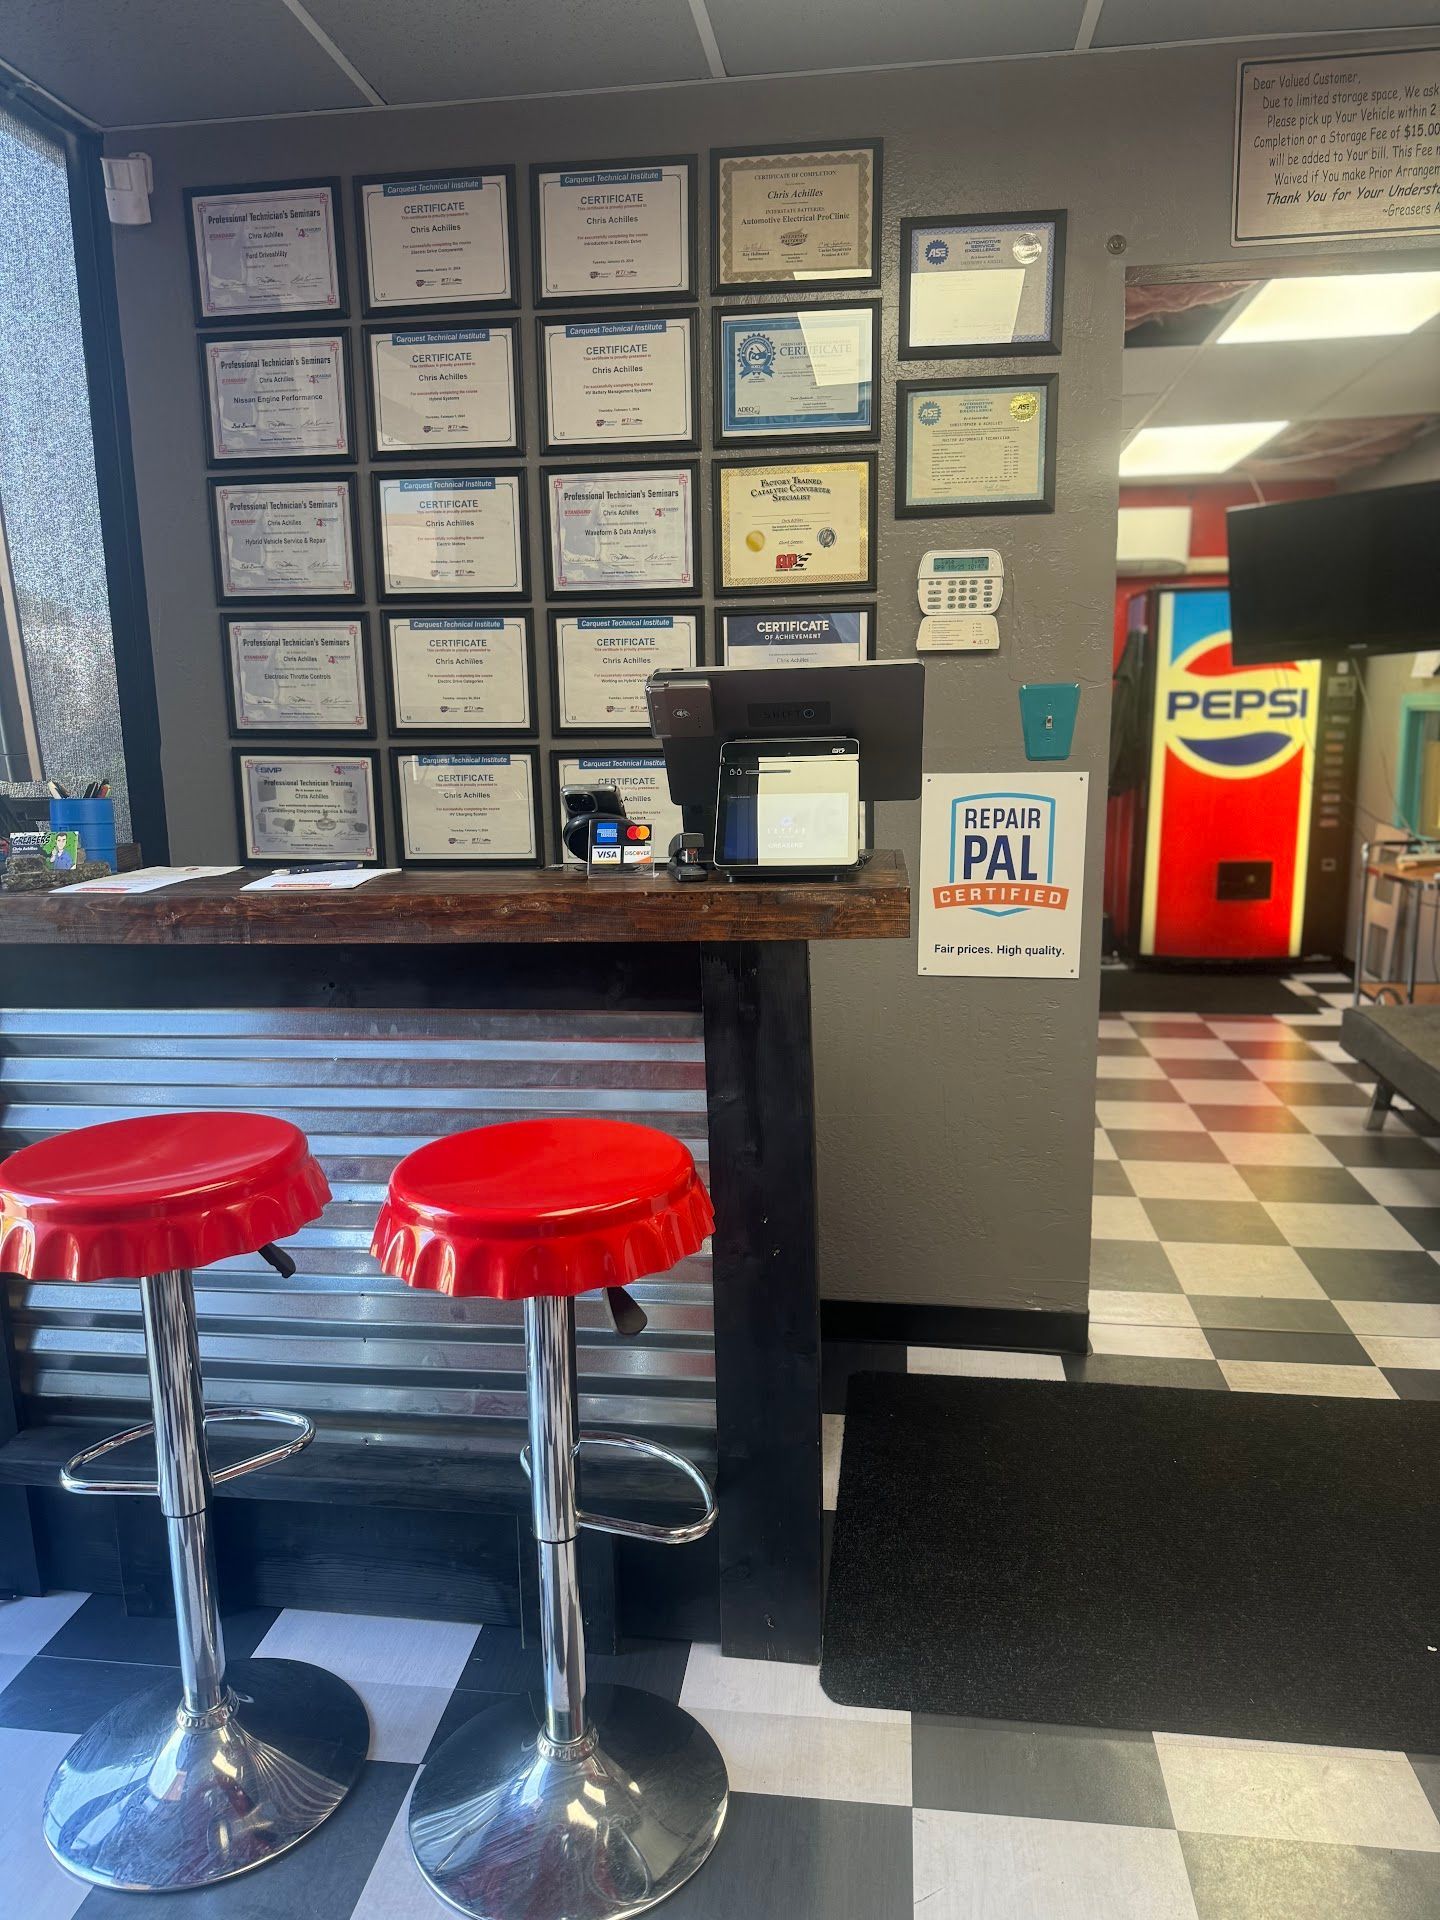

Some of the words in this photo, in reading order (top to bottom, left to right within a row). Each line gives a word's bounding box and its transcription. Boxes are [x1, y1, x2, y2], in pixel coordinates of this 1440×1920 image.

[1253, 78, 1275, 90] Dear
[1280, 74, 1310, 87] Valued
[1313, 73, 1361, 85] Customer,
[1263, 97, 1280, 109] Due
[1284, 97, 1293, 107] to
[1297, 94, 1329, 106] limited
[1332, 91, 1368, 107] storage
[1371, 89, 1401, 104] space,
[1404, 86, 1420, 97] We
[1423, 84, 1439, 97] ask
[1268, 115, 1297, 128] Please
[1300, 114, 1319, 130] pick
[1322, 115, 1332, 127] up
[1335, 111, 1358, 124] Your
[1361, 107, 1395, 121] Vehicle
[1398, 104, 1428, 118] within
[1430, 104, 1436, 115] 2
[1254, 134, 1305, 150] Completion
[1307, 134, 1317, 144] or
[1321, 134, 1326, 143] a
[1329, 131, 1367, 145] Storage
[1370, 127, 1387, 140] Fee
[1390, 126, 1400, 138] of
[1404, 123, 1440, 138] $15.00
[1269, 153, 1284, 167] will
[1288, 154, 1299, 165] be
[1302, 150, 1330, 164] added
[1334, 152, 1343, 162] to
[1346, 149, 1369, 162] Your
[1371, 145, 1389, 159] bill.
[1392, 145, 1413, 158] This
[1416, 143, 1433, 156] Fee
[564, 176, 595, 184] Carquest
[630, 172, 658, 180] Institute
[1275, 171, 1308, 186] Waived
[1312, 171, 1319, 183] if
[1322, 170, 1339, 182] You
[1342, 168, 1366, 181] make
[1369, 166, 1392, 179] Prior
[388, 185, 417, 194] Carquest
[419, 183, 450, 191] Technical
[452, 180, 479, 188] Institute
[580, 193, 644, 205] CERTIFICATE
[768, 190, 789, 200] Chris
[791, 189, 823, 198] Achilles
[1266, 192, 1301, 205] Thank
[1306, 190, 1326, 202] You
[1332, 188, 1351, 202] for
[1357, 187, 1384, 199] Your
[404, 202, 465, 214] CERTIFICATE
[208, 214, 248, 224] Professional
[250, 210, 288, 222] Technician's
[290, 209, 320, 218] Seminars
[741, 216, 780, 225] Automotive
[783, 215, 815, 223] Electrical
[817, 212, 849, 220] ProClinic
[432, 224, 461, 232] Achilles
[928, 248, 946, 257] ASE
[570, 327, 600, 335] Carquest
[396, 335, 426, 343] Carquest
[428, 333, 458, 341] Technical
[586, 344, 648, 355] CERTIFICATE
[221, 360, 259, 369] Professional
[262, 358, 299, 367] Technician's
[302, 356, 331, 365] Seminars
[412, 352, 472, 363] CERTIFICATE
[258, 396, 279, 404] Engine
[921, 409, 939, 417] ASE
[404, 482, 432, 490] Carquest
[434, 480, 464, 488] Technical
[760, 479, 790, 487] FACTORY
[564, 492, 604, 500] Professional
[607, 490, 646, 499] Technician's
[648, 490, 678, 498] Seminars
[751, 488, 788, 497] CATALYTIC
[789, 484, 831, 494] CONVERTER
[772, 494, 811, 502] SPECIALIST
[230, 502, 268, 511] Professional
[270, 501, 307, 509] Technician's
[309, 500, 338, 508] Seminars
[420, 500, 478, 509] CERTIFICATE
[582, 620, 610, 628] Carquest
[756, 621, 829, 632] CERTIFICATE
[596, 638, 656, 646] CERTIFICATE
[1167, 688, 1308, 720] PEPSI
[438, 774, 494, 782] CERTIFICATE
[330, 780, 352, 788] Training
[964, 808, 1041, 829] REPAIR
[963, 835, 1038, 881] PAL
[939, 887, 1062, 905] CERTIFIED
[934, 944, 955, 954] Fair
[957, 945, 993, 956] prices.
[997, 945, 1022, 956] High
[1025, 945, 1065, 958] quality.
